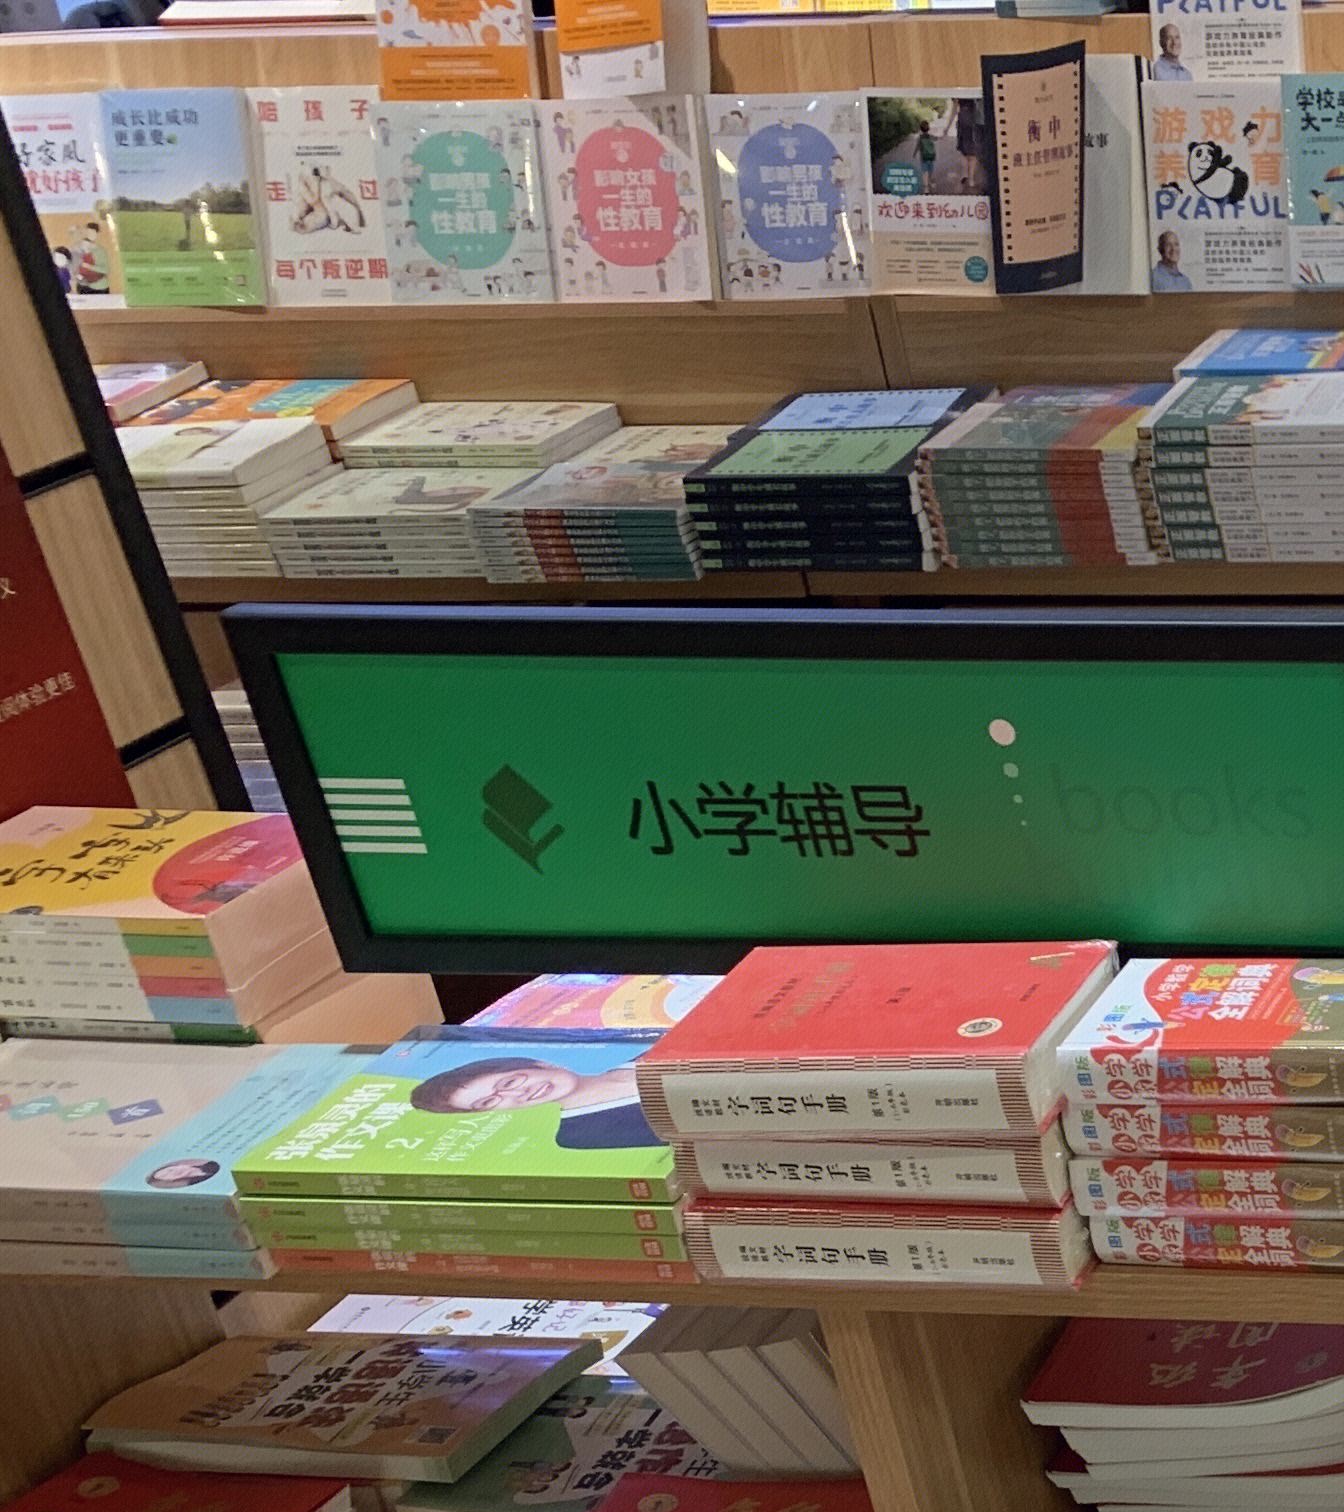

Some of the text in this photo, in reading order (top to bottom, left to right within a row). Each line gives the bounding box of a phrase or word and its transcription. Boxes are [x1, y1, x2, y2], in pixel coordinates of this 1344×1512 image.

[1152, 106, 1282, 144] 游戏力
[596, 207, 663, 231] 性教育
[627, 777, 934, 861] 小学辅导
[728, 1094, 849, 1115] 字词句手册
[757, 1162, 871, 1184] 字词句手册
[773, 1245, 889, 1266] 字词句手册
